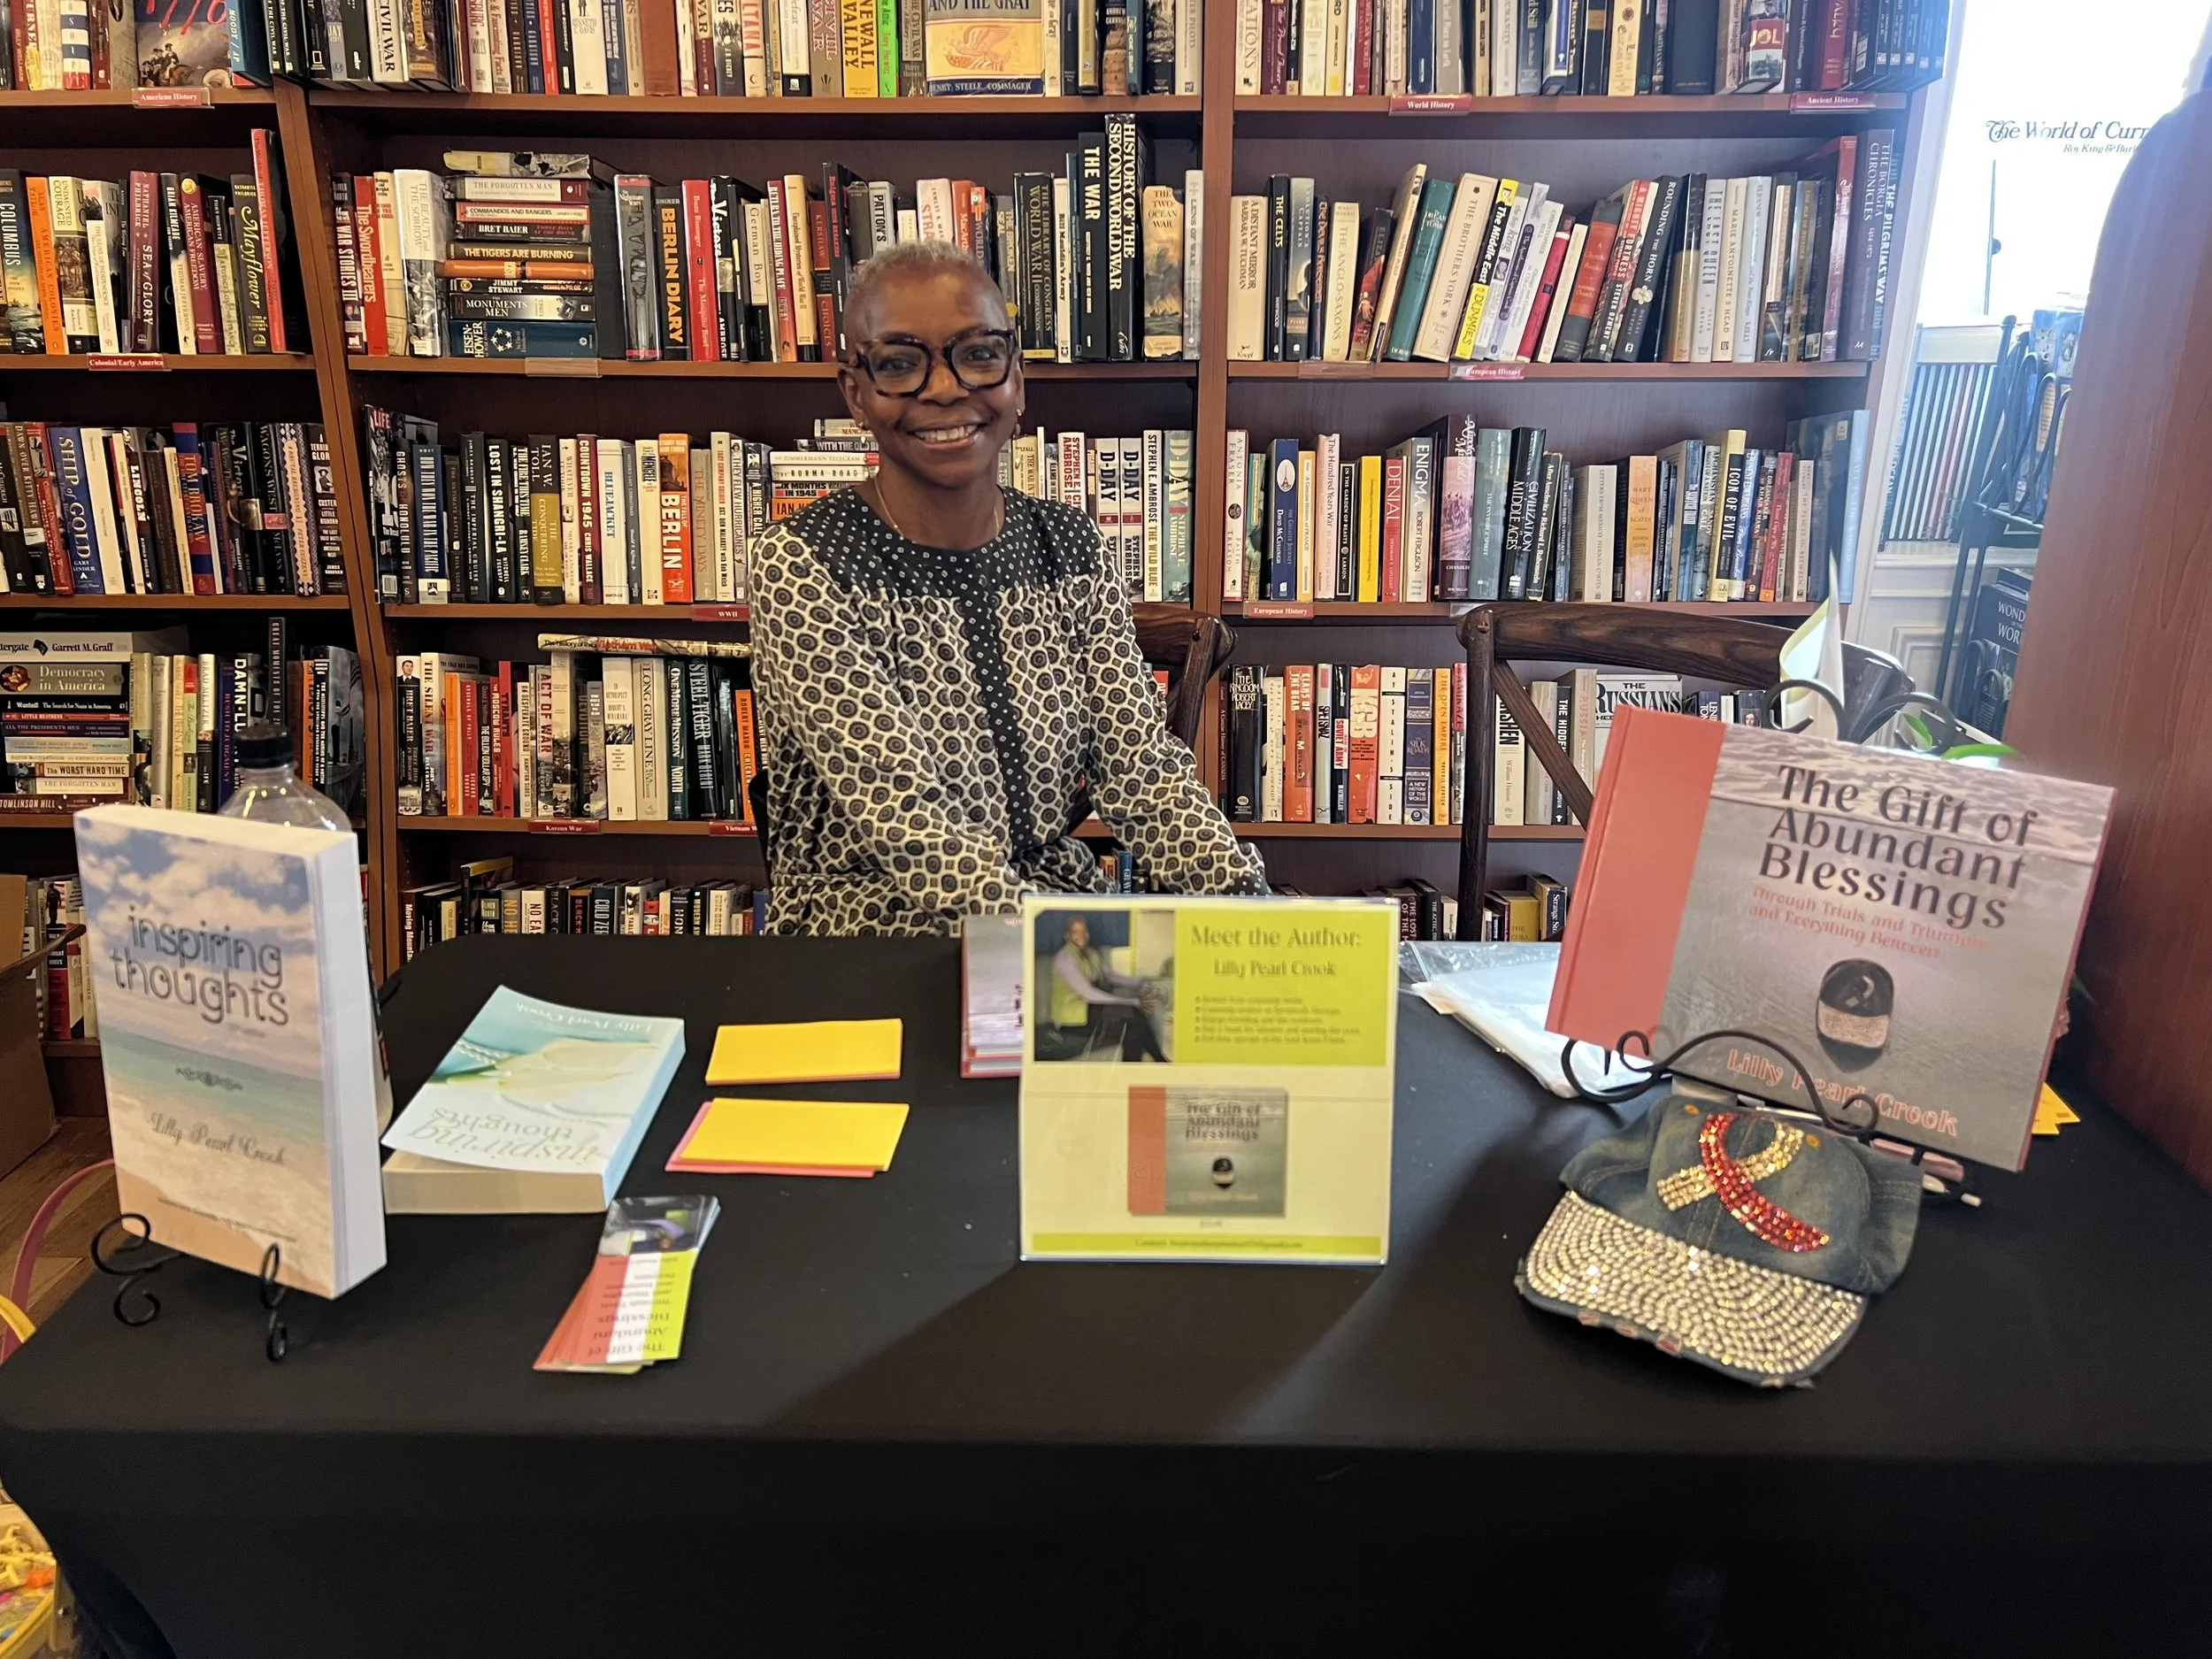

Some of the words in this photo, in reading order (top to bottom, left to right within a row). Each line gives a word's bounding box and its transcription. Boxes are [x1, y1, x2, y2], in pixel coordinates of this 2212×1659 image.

[1430, 101, 1455, 110] History
[1833, 96, 1859, 105] History
[1985, 120, 2020, 142] The
[2025, 121, 2078, 139] World
[2079, 121, 2102, 139] of
[1084, 147, 1102, 179] THE
[1108, 123, 1122, 193] SECOND
[1123, 123, 1136, 188] HISTORY
[356, 204, 369, 225] The
[1085, 184, 1101, 220] WAR
[1123, 192, 1135, 212] OF
[1275, 195, 1284, 221] THE
[1463, 200, 1478, 222] THE
[1496, 206, 1508, 226] The
[1656, 181, 1677, 235] ROUNDING
[0, 203, 21, 266] COLUMBUS
[336, 223, 351, 243] WAR
[1109, 195, 1122, 251] WORLD
[1123, 214, 1134, 258] THE
[142, 244, 152, 267] SEA
[240, 205, 265, 308] Mayflower
[530, 250, 573, 258] BURNING
[661, 208, 680, 279] BERLIN
[1451, 224, 1473, 280] BROTHERS
[1487, 227, 1502, 260] Middle
[338, 245, 356, 285] STORIES
[357, 225, 377, 303] Swordbearers
[1109, 253, 1122, 290] WAR
[1479, 261, 1492, 284] East
[1645, 253, 1658, 281] HORN
[142, 280, 154, 325] GLORY
[1443, 282, 1456, 305] YORK
[667, 282, 683, 343] DIARY
[474, 321, 483, 357] HOWER
[373, 410, 391, 429] LIFE
[14, 425, 27, 451] DAWN
[1148, 434, 1157, 471] STEPHEN
[1327, 439, 1336, 452] The
[21, 454, 32, 472] OVER
[58, 436, 81, 487] SHIP
[488, 444, 502, 473] LOST
[579, 440, 591, 499] COUNTDOWN
[733, 456, 742, 476] THEY
[1169, 439, 1189, 506] D-DAY
[1327, 454, 1336, 487] Hundred
[25, 472, 35, 497] KITTY
[492, 476, 502, 488] IN
[733, 479, 743, 500] FLEW
[1100, 452, 1117, 502] D-DAY
[1124, 451, 1140, 501] D-DAY
[1415, 444, 1431, 506] ENIGMA
[1727, 467, 1741, 493] ICON
[130, 465, 147, 522] LINCOLN
[1148, 482, 1157, 523] AMBROSE
[1386, 465, 1402, 524] DENIAL
[1725, 497, 1738, 510] OF
[28, 499, 39, 526] HAWK
[492, 488, 508, 554] SHANGRI-LA
[581, 502, 593, 528] 1945
[1722, 513, 1738, 541] EVIL
[69, 502, 92, 559] GOLD
[583, 532, 592, 552] CHRIS
[661, 495, 683, 569] BERLIN
[734, 502, 745, 555] HURRICANES
[1148, 526, 1157, 541] THE
[1148, 543, 1157, 561] WILD
[1148, 563, 1157, 587] BLUE
[51, 642, 82, 652] Garrett
[84, 642, 92, 651] M.
[93, 642, 113, 652] Graff
[39, 665, 106, 680] Democracy
[39, 680, 55, 691] in
[58, 679, 106, 692] America
[539, 673, 552, 696] ACT
[541, 699, 552, 722] OF
[541, 725, 552, 754] WAR
[0, 798, 38, 810] TOMLINSON
[41, 799, 56, 809] HILL
[1777, 764, 1862, 812] The
[1876, 784, 1970, 833] Gift
[1984, 810, 2040, 847] of
[1767, 807, 2026, 889] Abundant
[1757, 842, 2008, 930] Blessings
[1871, 912, 1905, 932] and
[127, 904, 283, 991] inspiring
[1191, 926, 1241, 948] Meet
[1247, 925, 1283, 948] the
[1286, 926, 1363, 949] Author:
[1214, 959, 1248, 980] Lilly
[1249, 959, 1287, 978] Pearl
[1290, 959, 1337, 978] Crook
[109, 946, 290, 1026] thoughts
[1725, 1046, 1785, 1088] Lilly
[1874, 1094, 1959, 1137] Crook
